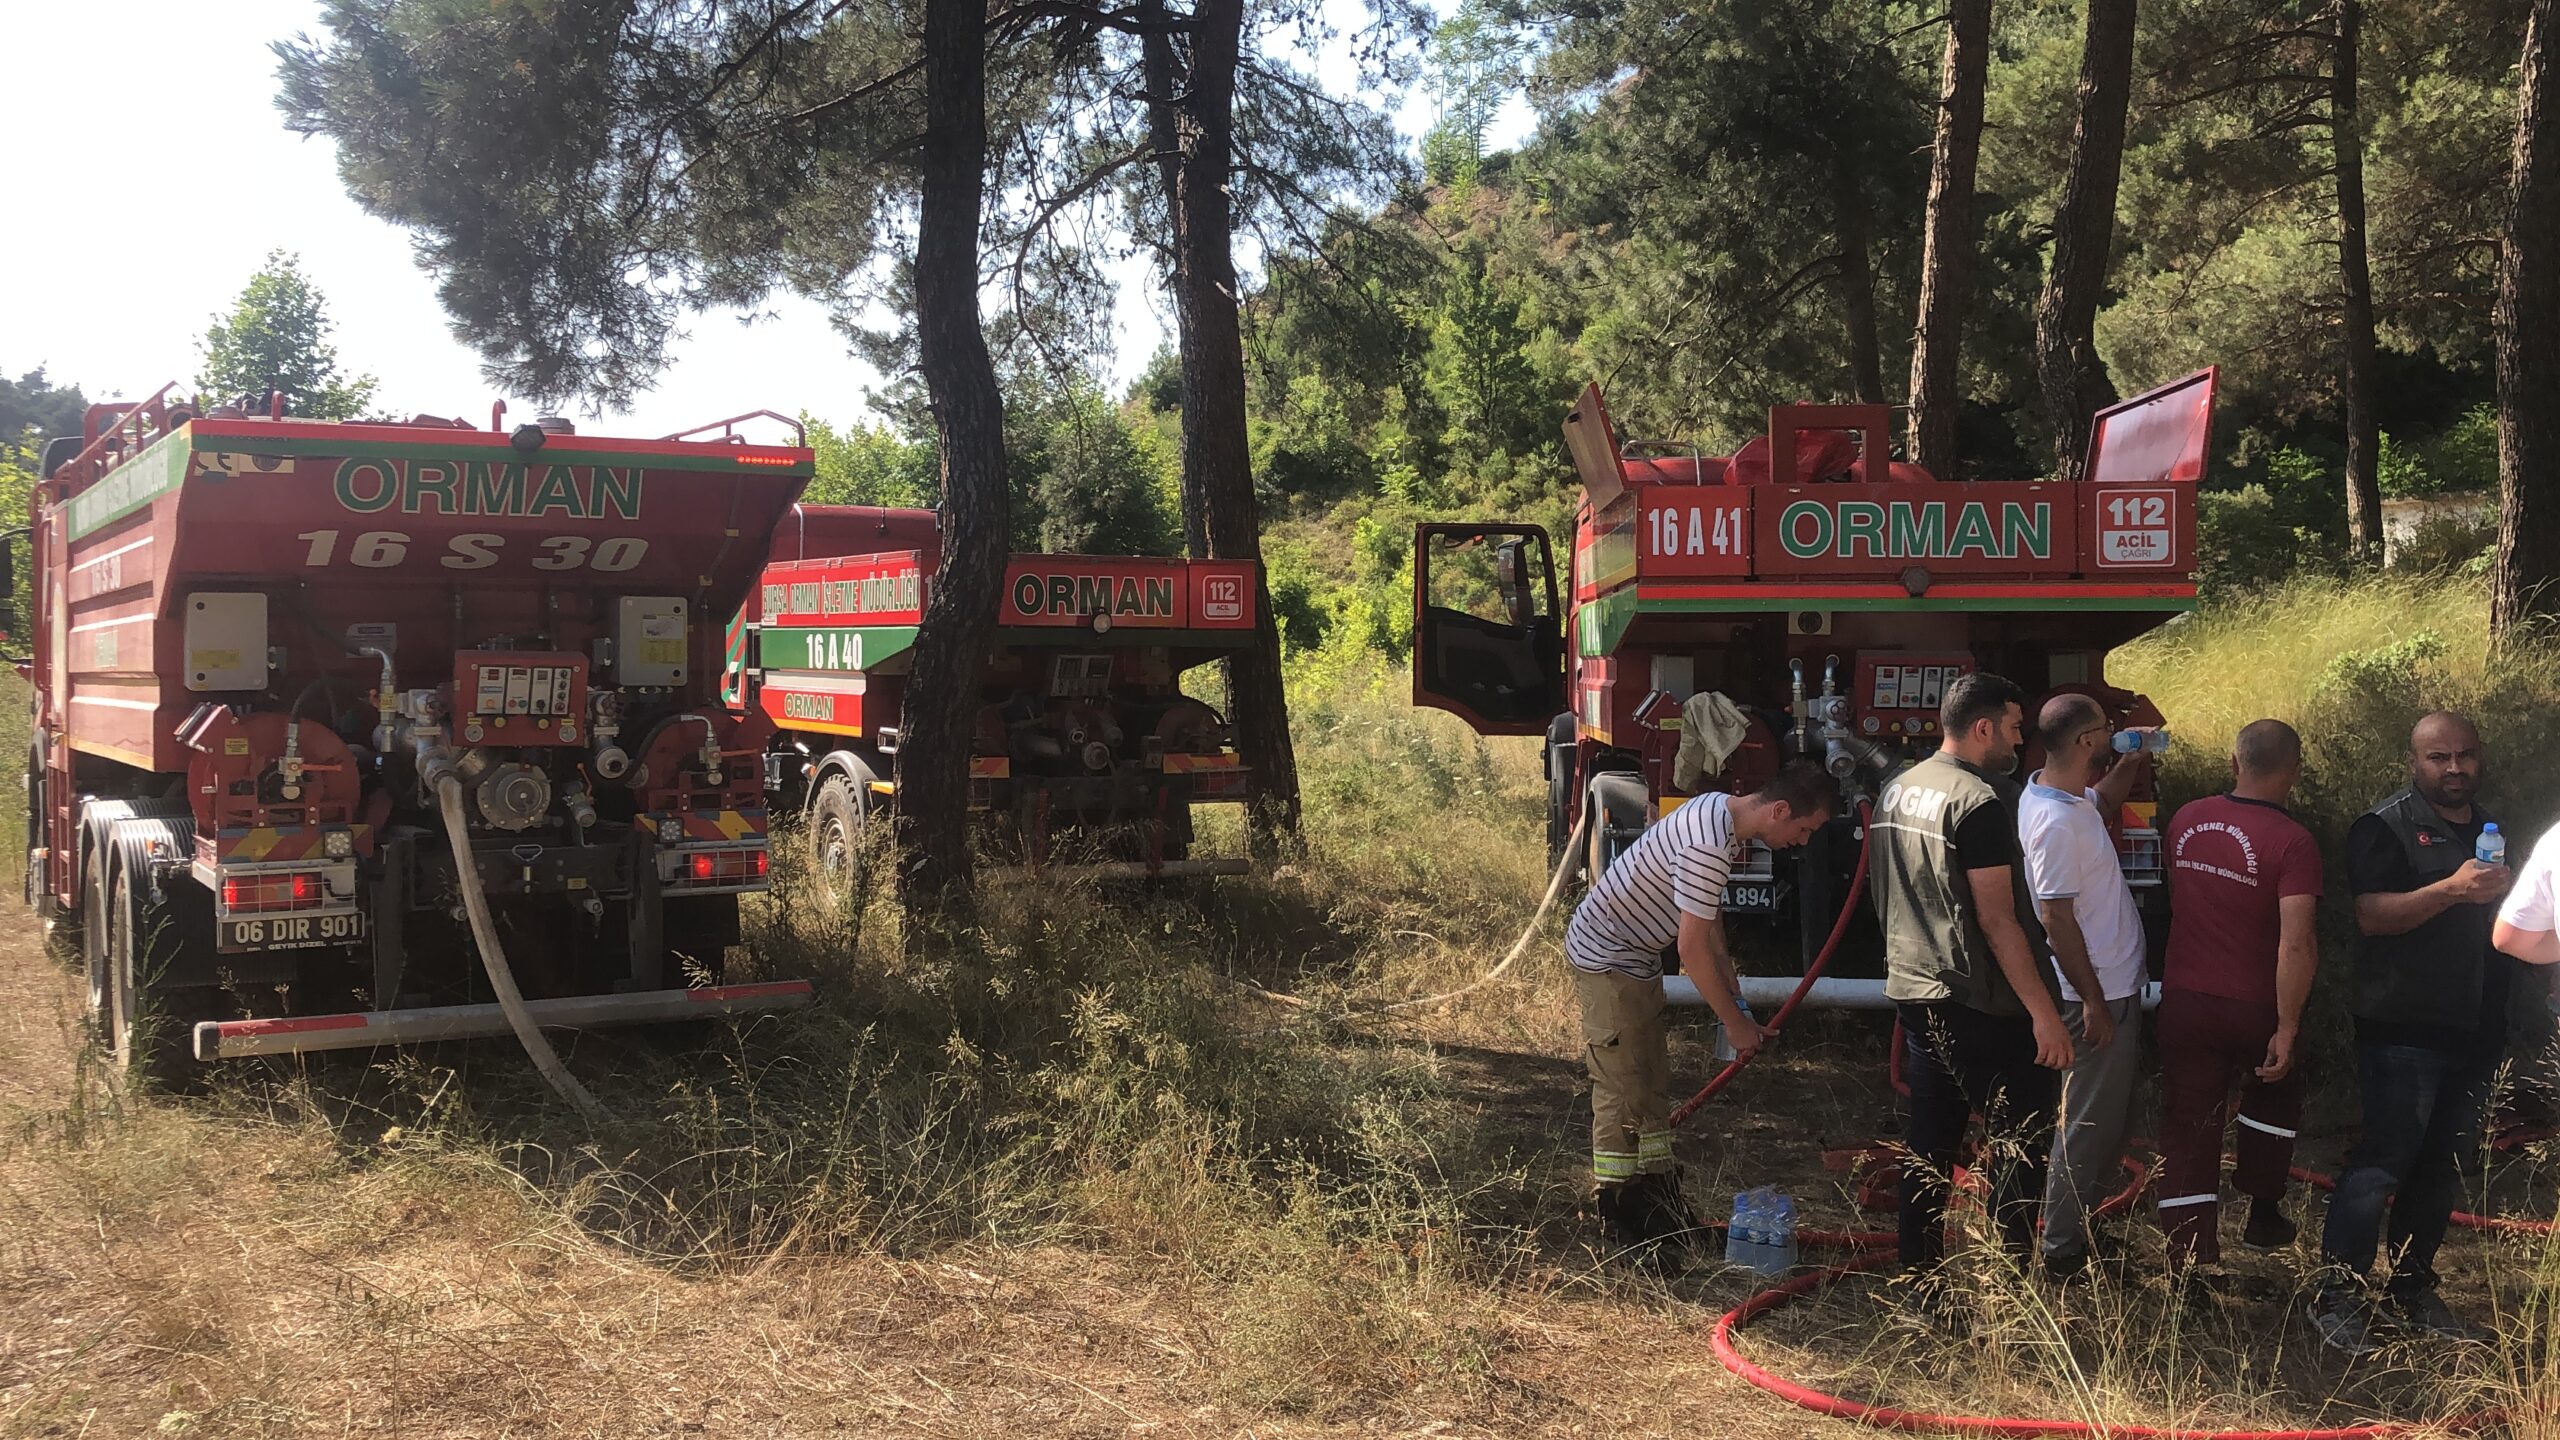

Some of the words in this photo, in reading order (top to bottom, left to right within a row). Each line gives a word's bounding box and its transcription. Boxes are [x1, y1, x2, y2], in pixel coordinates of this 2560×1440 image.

[333, 457, 644, 520] ORMAN
[2107, 497, 2165, 526] 112
[1648, 507, 1678, 556] 16
[1686, 507, 1705, 555] A
[1712, 507, 1742, 555] 41
[1779, 500, 2051, 559] ORMAN
[2116, 532, 2156, 548] ACİL
[298, 530, 411, 568] 16
[440, 533, 506, 569] S
[531, 536, 649, 572] 30
[2121, 548, 2152, 560] ÇAĞRI
[763, 584, 789, 615] BURSA
[790, 582, 820, 615] ORMAN
[822, 576, 859, 618] İŞLETME
[860, 568, 920, 614] MÜDÜRLÜĞÜ
[1013, 573, 1173, 618] ORMAN
[1210, 581, 1236, 601] 112
[806, 634, 823, 669] 16
[827, 633, 839, 670] A
[842, 633, 863, 670] 40
[785, 693, 834, 721] ORMAN
[1883, 784, 1947, 822] OGM
[2176, 827, 2195, 856] ORMAN
[2196, 822, 2225, 832] GENEL
[1736, 887, 1770, 907] 894
[235, 921, 264, 944] 06
[273, 918, 310, 941] DIR
[320, 915, 358, 938] 901
